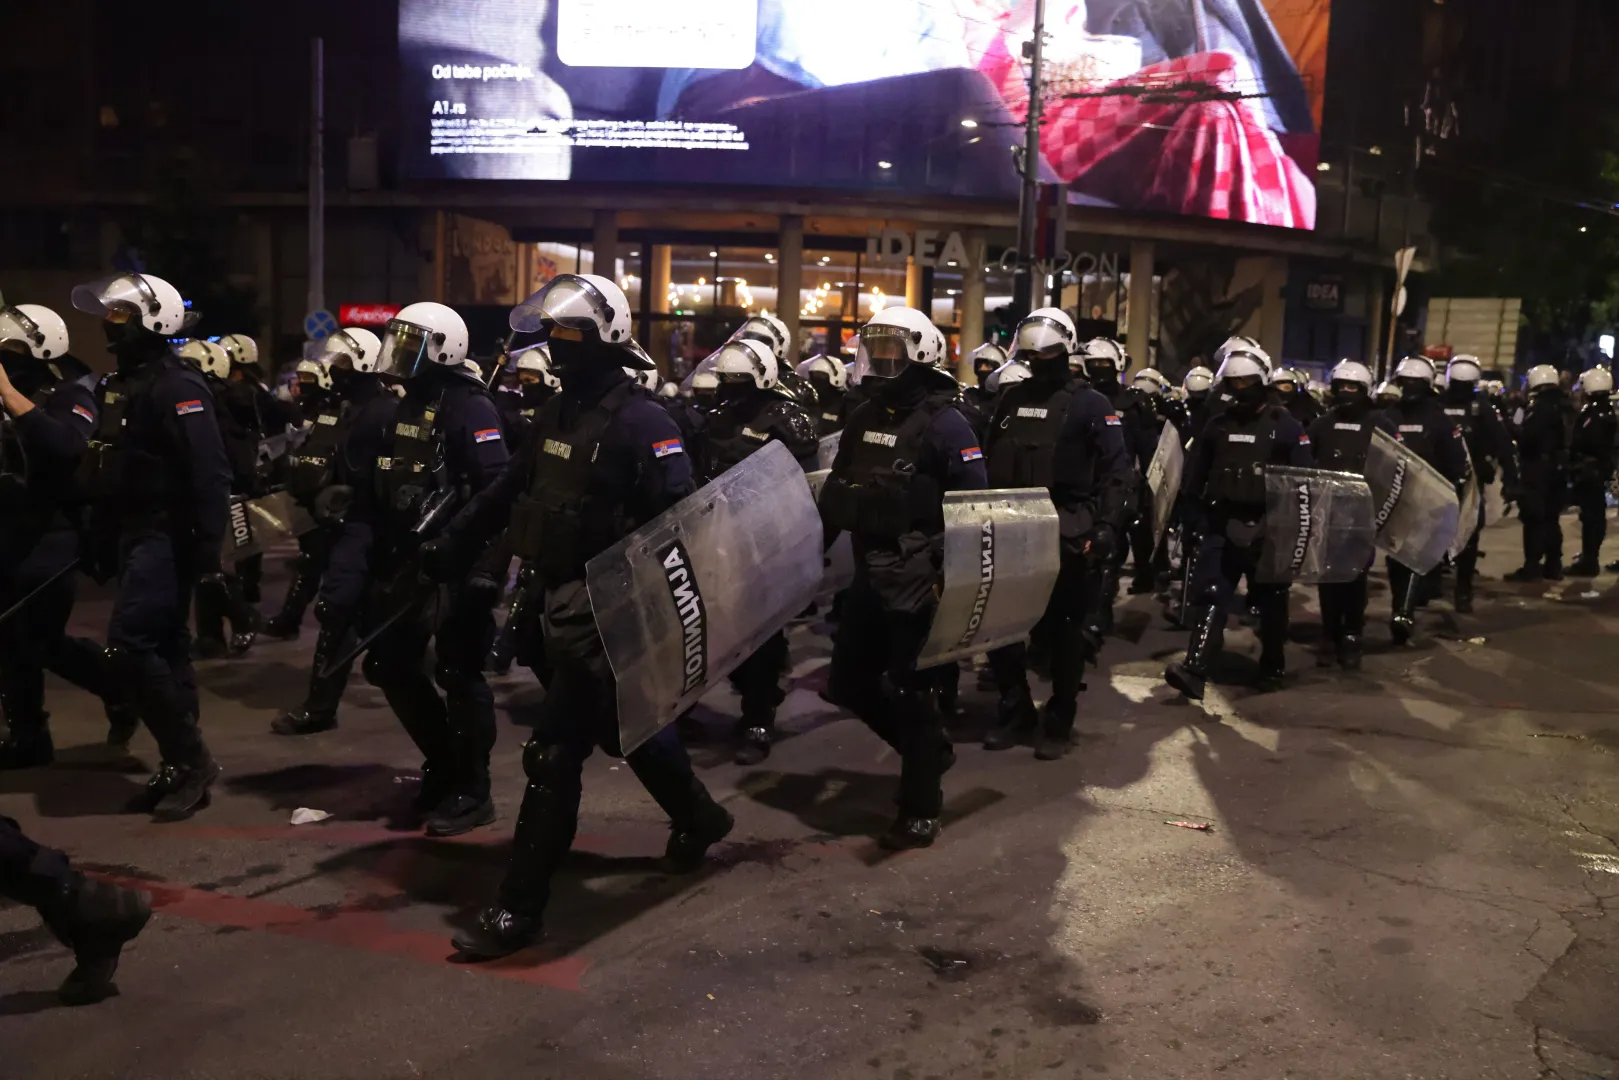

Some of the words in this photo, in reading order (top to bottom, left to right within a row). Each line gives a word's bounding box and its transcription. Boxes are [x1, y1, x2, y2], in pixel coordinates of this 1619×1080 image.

[432, 64, 451, 79] Od
[432, 100, 467, 115] A1.rs
[1290, 484, 1311, 568] ПОЛИЦИЈА
[663, 546, 703, 693] ПОЛИЦИЈА
[961, 519, 994, 642] ПОЛИЦИЈА
